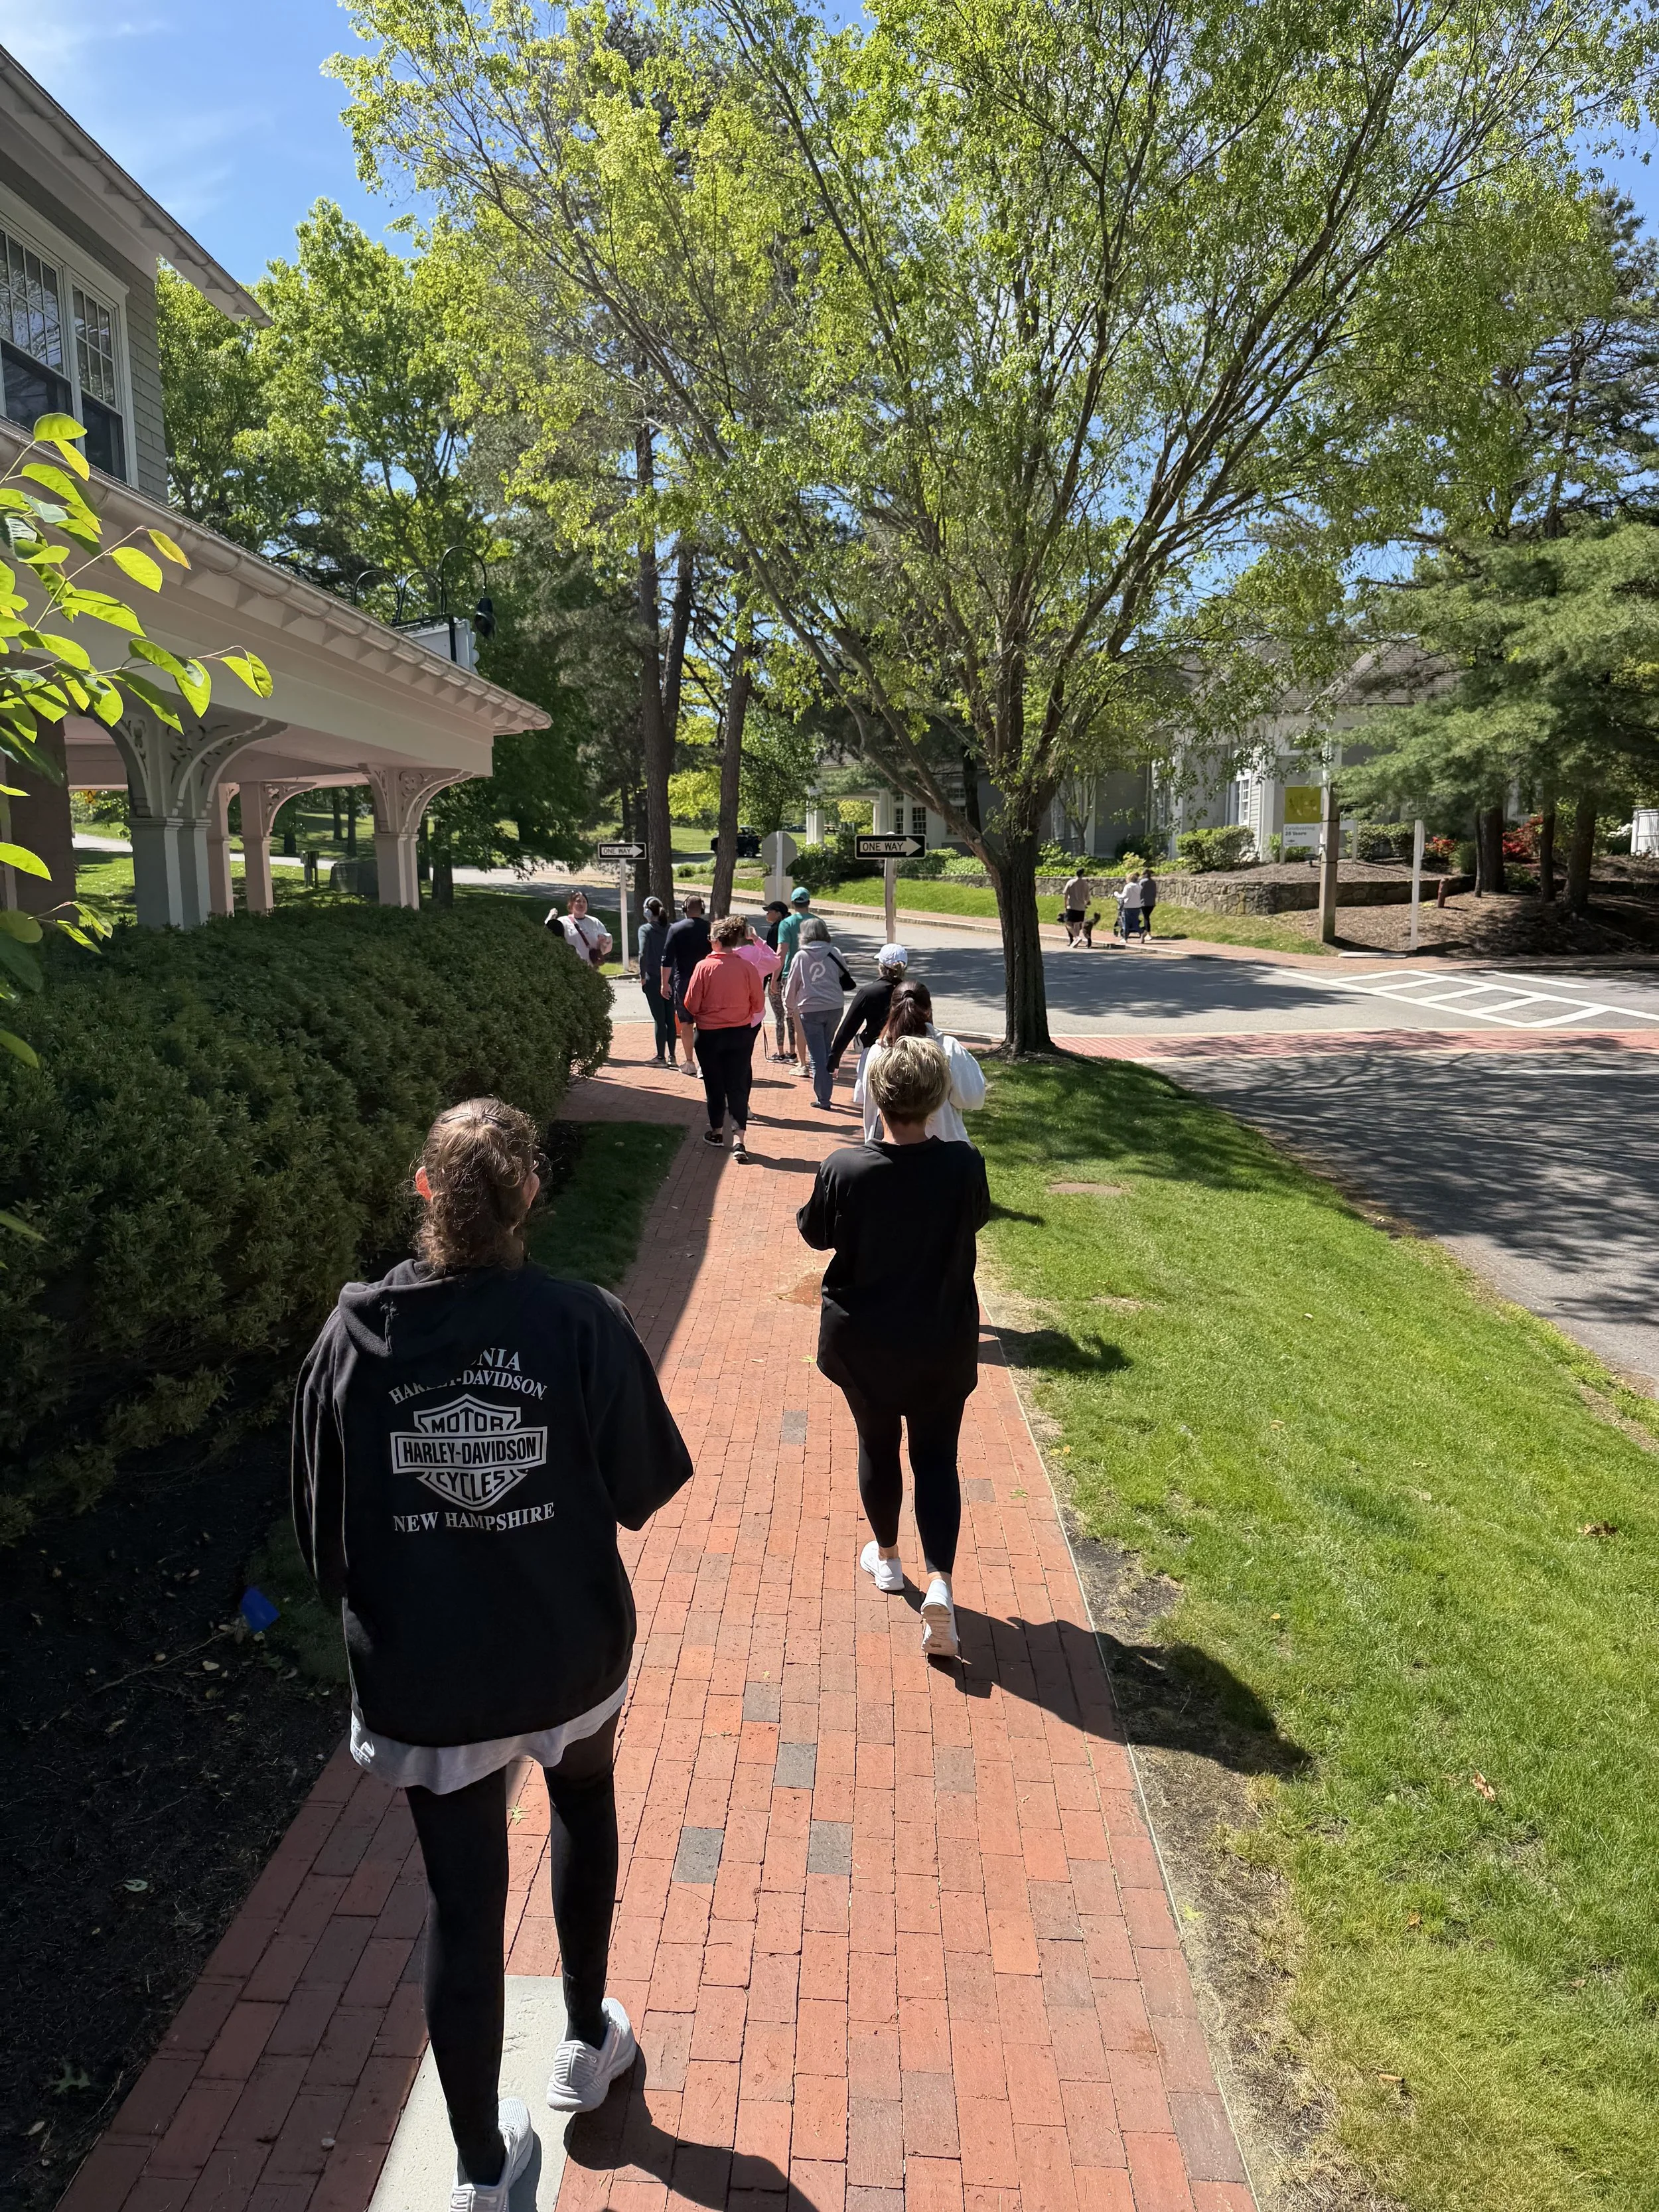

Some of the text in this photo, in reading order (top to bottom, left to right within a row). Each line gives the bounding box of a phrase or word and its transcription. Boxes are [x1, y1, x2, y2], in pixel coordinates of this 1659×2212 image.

[863, 842, 903, 851] ONE WAY
[470, 1347, 521, 1372] NIA
[389, 1369, 548, 1405] HAR-DAVIDSON
[431, 1406, 504, 1434] MOTOR
[403, 1436, 536, 1465] HARLEY-DAVIDSON
[436, 1469, 505, 1502] CYCLES
[393, 1502, 555, 1532] NEW HAMPSHIRE
